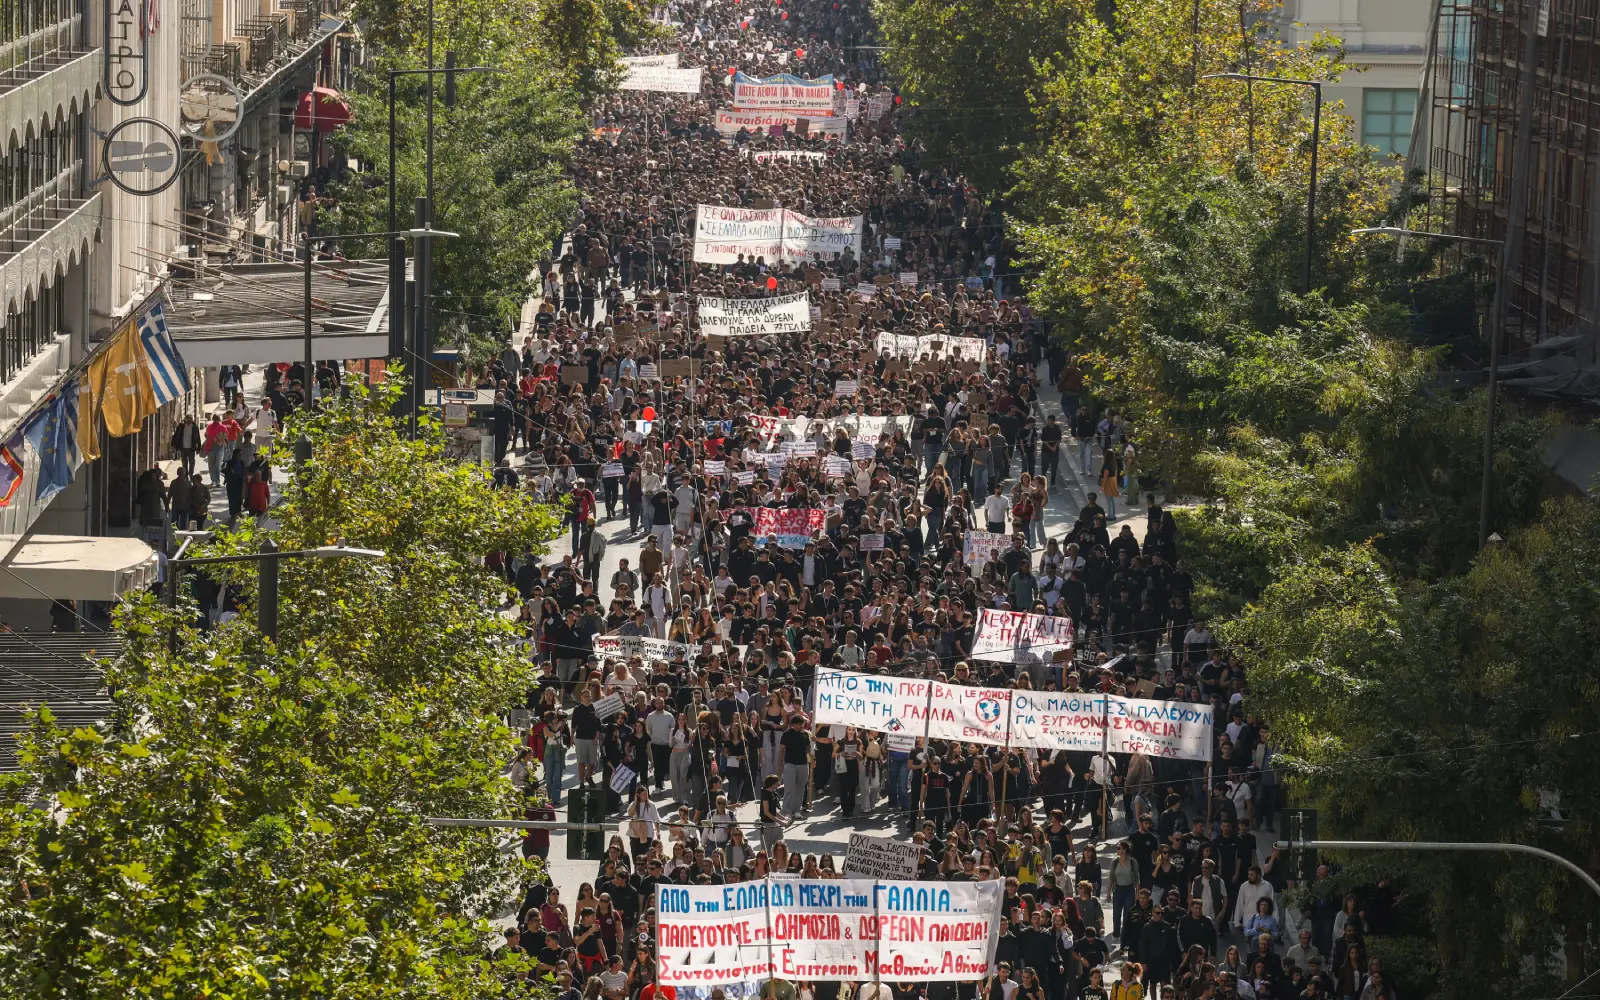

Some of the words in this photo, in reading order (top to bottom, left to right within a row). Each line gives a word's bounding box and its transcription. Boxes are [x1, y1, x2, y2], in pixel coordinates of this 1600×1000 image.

[757, 86, 777, 97] ΛΕΦΤΑ
[792, 86, 804, 98] ΤΗΝ
[805, 87, 830, 98] ΠΑΙΔΕΙΑ
[719, 114, 733, 124] Τα
[735, 115, 773, 125] παιδιά
[703, 207, 718, 220] ΣΕ
[705, 221, 717, 235] ΣΕ
[697, 298, 718, 308] ΑΠΟ
[720, 299, 739, 309] ΤΗΝ
[740, 299, 777, 309] ΕΛΛΑΔΑ
[777, 293, 808, 305] ΜΕΧΡΙ
[700, 315, 744, 326] ΠΑΛΕΥΟΥΜΕ
[764, 313, 794, 323] ΔΩΡΕΑΝ
[738, 308, 770, 317] ΓΑΛΛΙΑ
[971, 538, 995, 546] ANOTHER
[599, 640, 620, 648] 500+
[818, 672, 858, 691] ΑΠΟ
[865, 679, 893, 696] ΤΗΝ
[899, 682, 953, 700] ΓΚΡΑΒΑ
[965, 689, 977, 698] LE
[979, 690, 1012, 701] MONDE
[819, 693, 866, 714] ΜΕΧΡΙ
[871, 701, 893, 717] ΤΗ
[901, 704, 955, 722] ΓΑΛΛΙΑ
[1016, 696, 1033, 711] ΟΙ
[1047, 699, 1127, 716] ΜΑΘΗΤΕΣ
[1137, 705, 1211, 726] ΠΑΛΕΥΟΥΝ
[963, 726, 983, 737] EST
[1015, 714, 1035, 725] ΓΙΑ
[1041, 714, 1109, 729] ΣΥΓΧΡΟΝΑ
[1113, 716, 1182, 739] ΣΧΟΛΕΙΑ!
[1121, 740, 1181, 759] ΓΚΡΑΒΑΣ
[850, 834, 870, 849] ΟΧΙ
[848, 846, 905, 865] ΠΑΝΕΠΙΣΤΗΜΙΑ
[901, 865, 913, 874] ΤΟ
[660, 888, 690, 913] ΑΠΟ
[694, 900, 720, 912] ΤΗΝ
[722, 882, 794, 912] ΕΛΛΑΔΑ
[799, 884, 841, 908] ΜΕΧΡΙ
[843, 895, 868, 908] ΤΗΝ
[658, 920, 752, 948] ΠΑΛΕΥΟΥΜΕ
[774, 913, 840, 941] ΔΗΜΟΣΙΑ
[844, 926, 853, 940] &
[858, 914, 924, 942] ΔΩΡΕΑΝ
[928, 921, 989, 942] ΠΑΙΔΕΙΑ!
[658, 953, 778, 981] Συντονιστική
[782, 948, 858, 976] Επιτροπή
